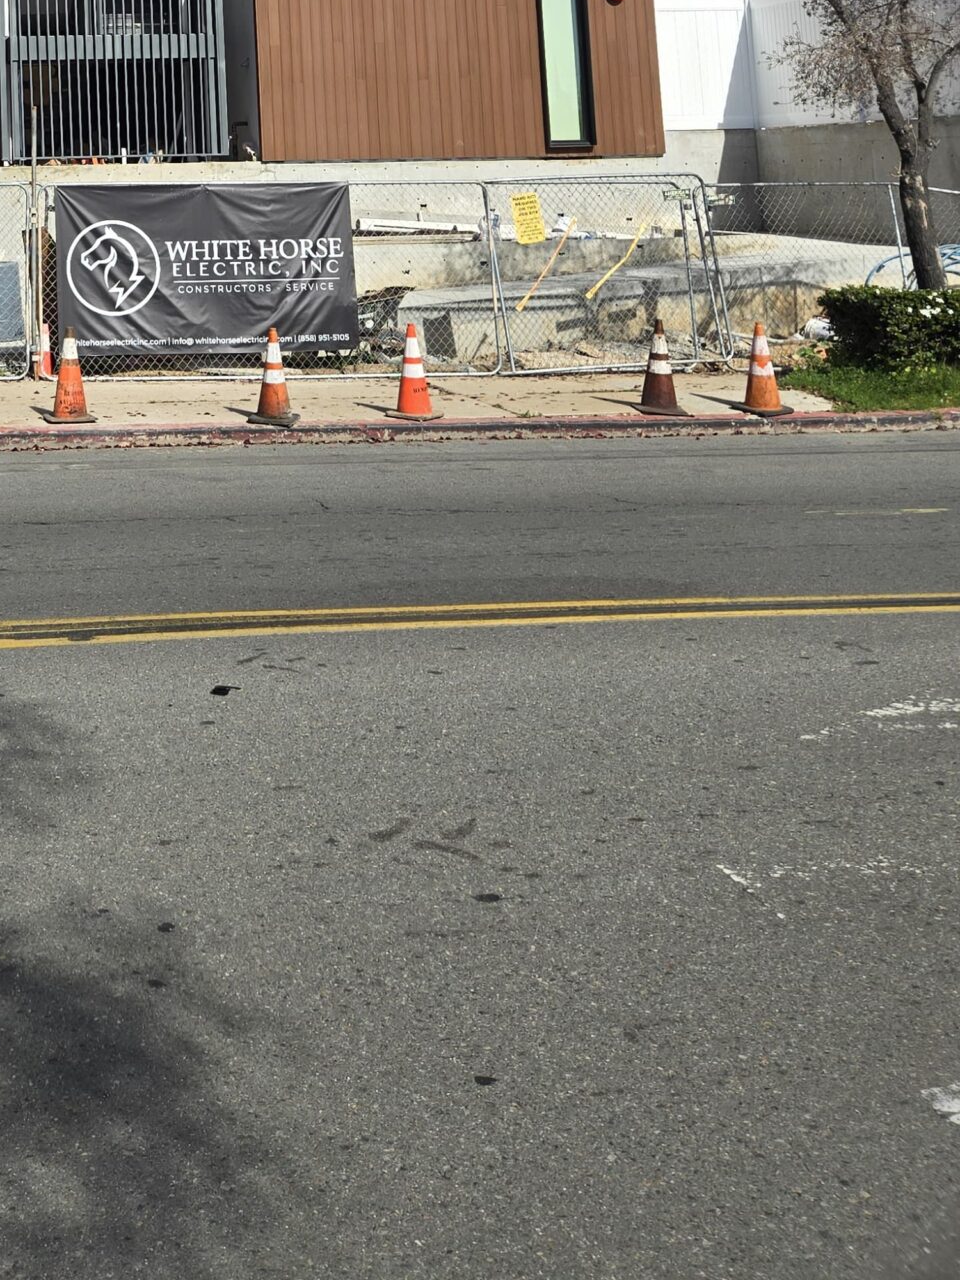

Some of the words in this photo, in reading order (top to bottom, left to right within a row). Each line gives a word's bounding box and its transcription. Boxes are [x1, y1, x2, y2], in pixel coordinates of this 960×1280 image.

[164, 239, 253, 262] WHITE
[258, 237, 345, 260] HORSE
[172, 261, 291, 278] ELECTRIC,
[301, 259, 340, 275] INC
[177, 283, 272, 294] CONSTRUCTORS
[285, 282, 335, 292] SERVICE
[75, 337, 167, 347] hitehorseelectricinc.com
[297, 333, 317, 344] (858)
[318, 332, 350, 342] 951-5105
